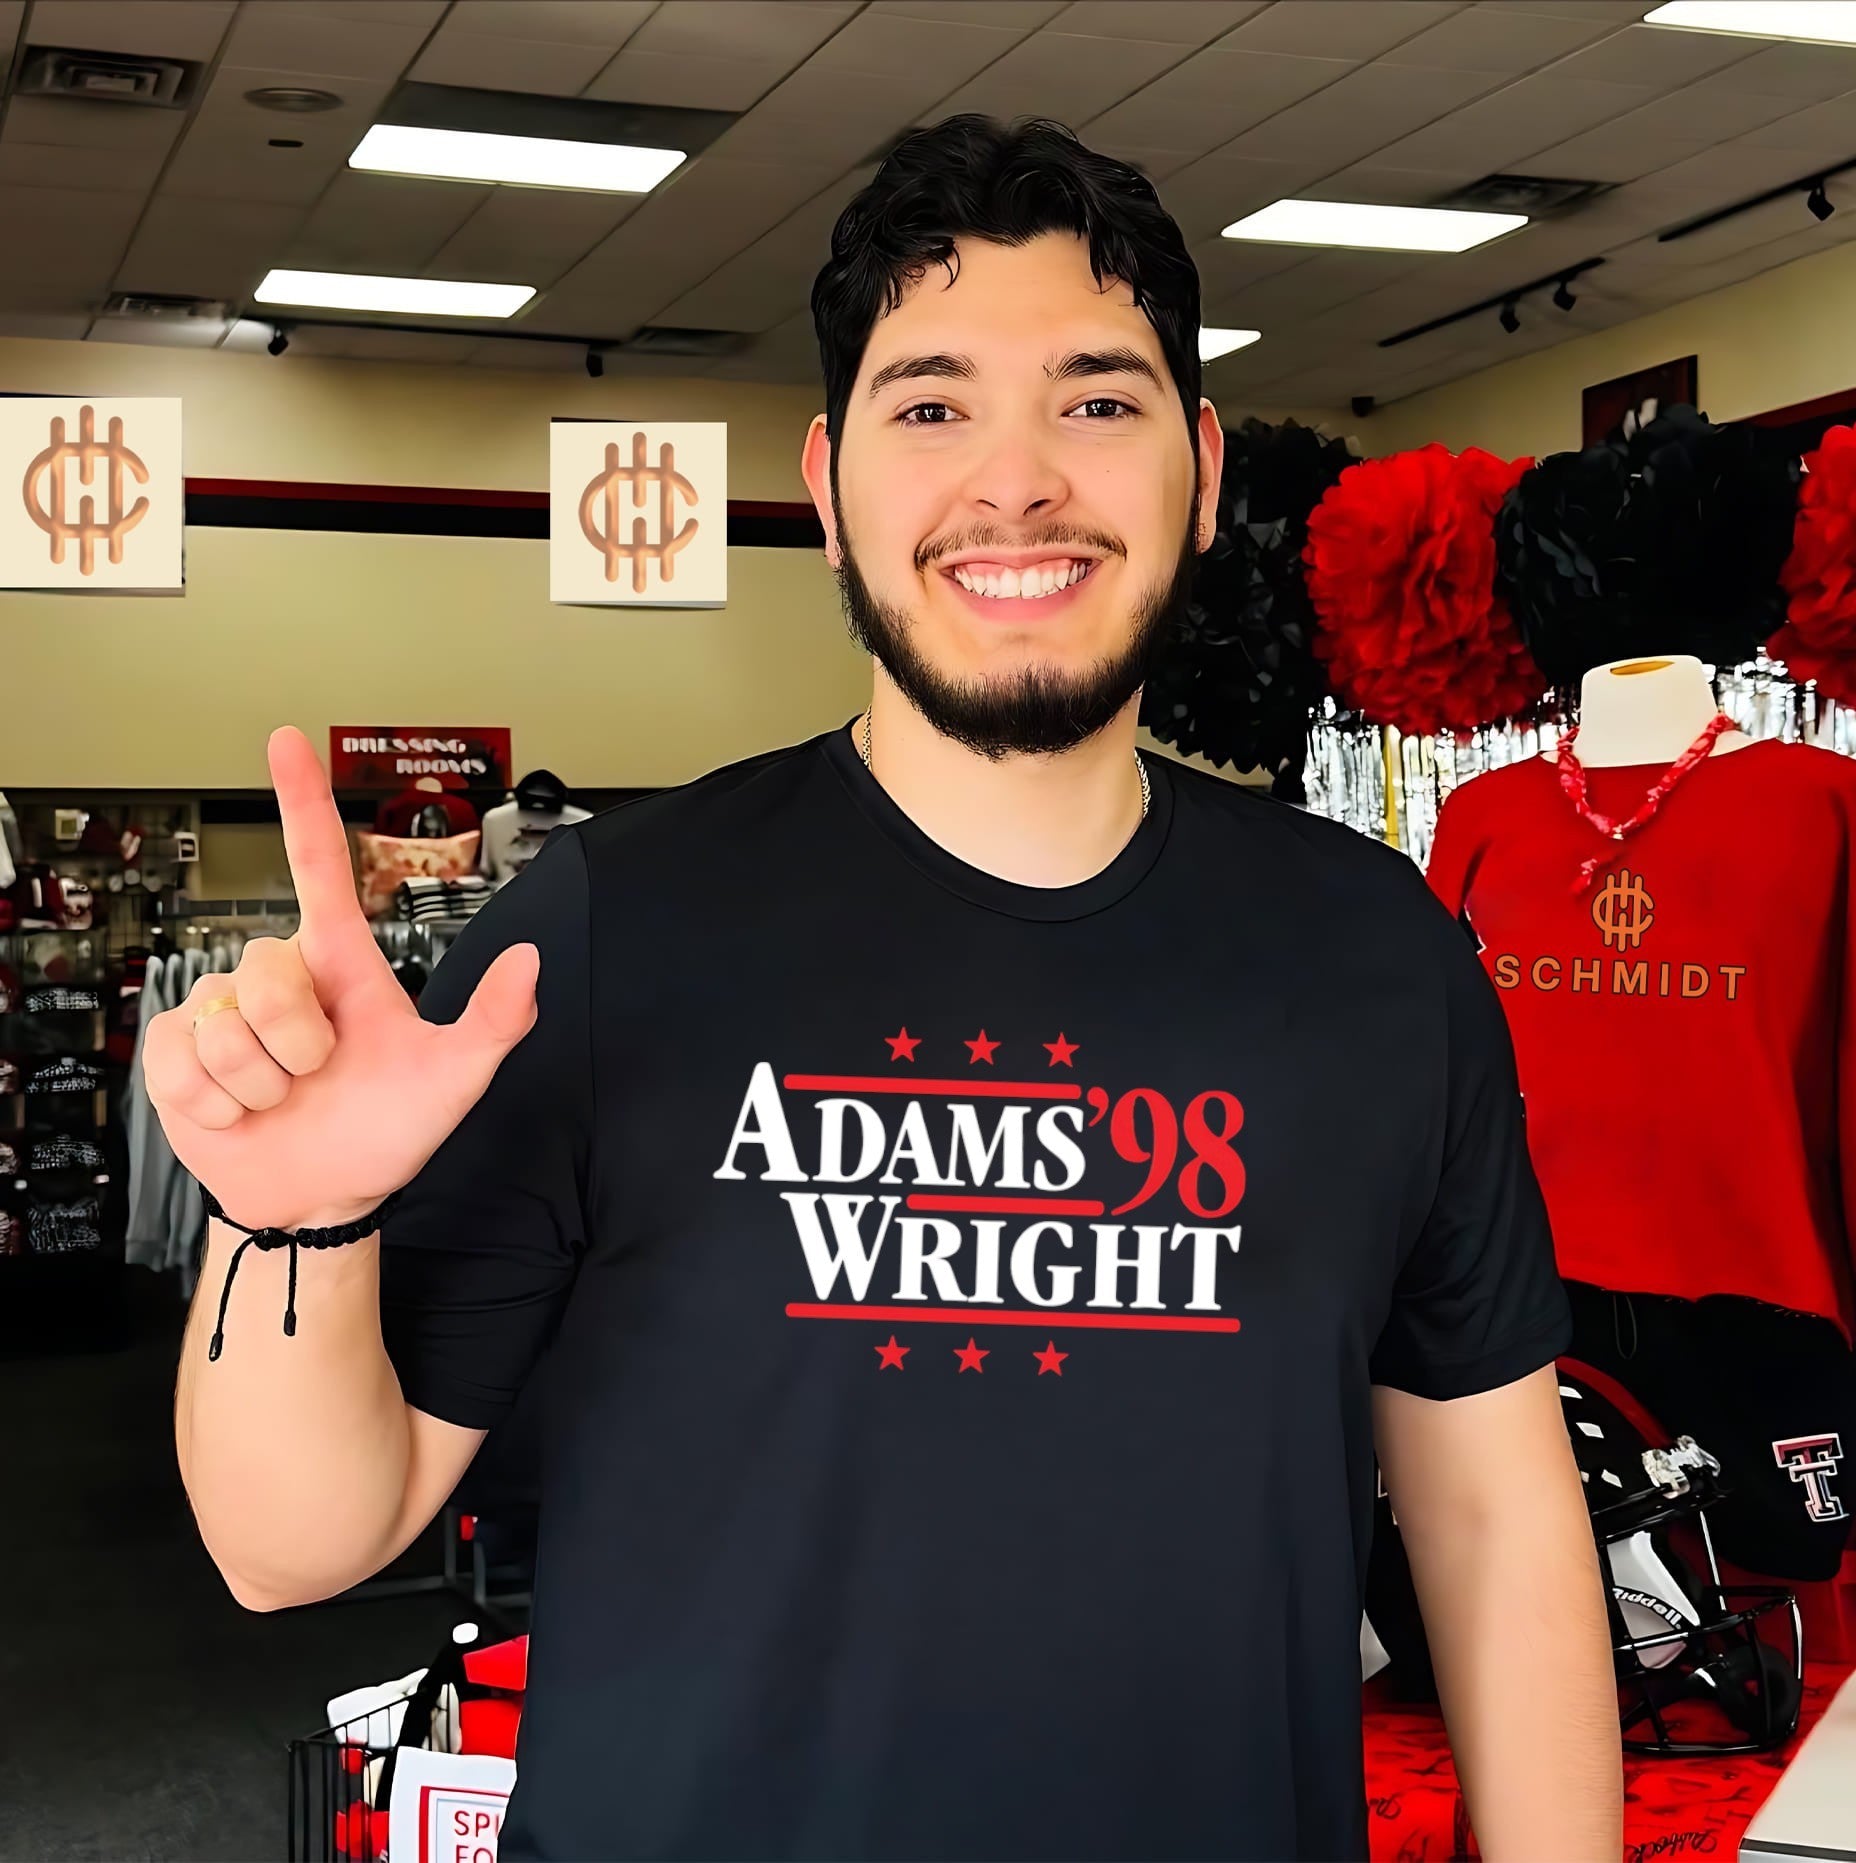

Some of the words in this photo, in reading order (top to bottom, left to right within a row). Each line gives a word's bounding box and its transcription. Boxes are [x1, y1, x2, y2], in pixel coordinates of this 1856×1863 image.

[342, 737, 467, 754] DRESSING
[396, 758, 487, 775] ROOMS
[1494, 953, 1747, 1001] SCHMIDT
[713, 1061, 1087, 1192] ADAMS
[1086, 1086, 1247, 1219] '98
[780, 1191, 1243, 1311] WRIGHT
